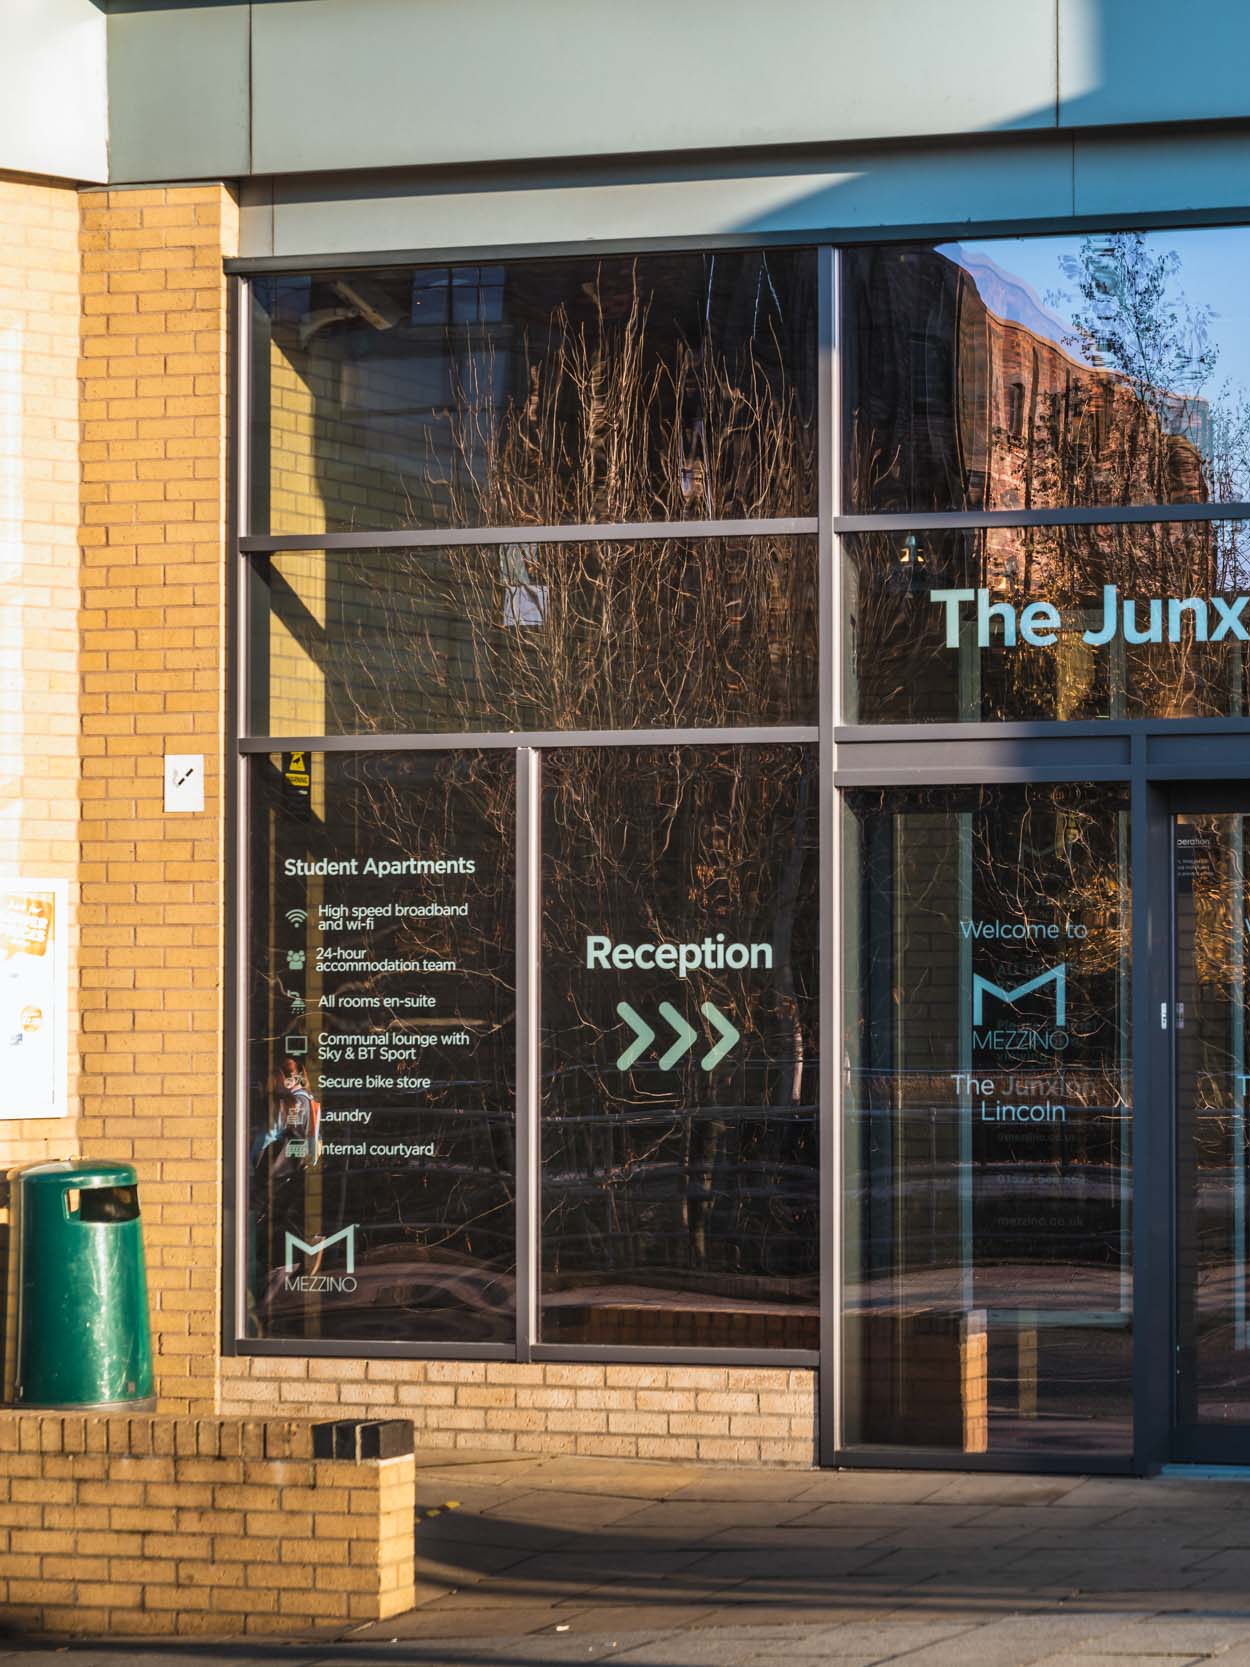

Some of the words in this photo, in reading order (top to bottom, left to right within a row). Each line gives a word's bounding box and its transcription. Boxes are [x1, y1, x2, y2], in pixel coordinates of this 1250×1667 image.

[930, 588, 1060, 648] The
[284, 858, 357, 876] Student
[363, 858, 475, 878] Apartments
[318, 904, 348, 918] High
[352, 904, 391, 918] speed
[395, 902, 468, 916] broadband
[318, 919, 343, 930] and
[346, 917, 374, 930] wi-fi
[960, 920, 1059, 939] Welcome
[1066, 921, 1088, 940] to
[315, 948, 366, 960] 24-hour
[586, 933, 773, 977] Reception
[316, 960, 420, 973] accommodation
[422, 960, 456, 971] team
[319, 996, 335, 1007] All
[338, 998, 380, 1008] rooms
[383, 996, 436, 1008] en-suite
[318, 1033, 389, 1046] Communal
[392, 1033, 437, 1048] lounge
[440, 1032, 469, 1045] with
[972, 1030, 1069, 1051] MEZZINO
[318, 1047, 342, 1062] Sky
[345, 1048, 355, 1059] &
[358, 1048, 376, 1059] BT
[379, 1046, 416, 1062] Sport
[318, 1075, 363, 1088] Secure
[366, 1075, 394, 1088] bike
[396, 1077, 431, 1088] store
[951, 1075, 995, 1095] The
[319, 1109, 372, 1124] Laundry
[981, 1100, 1066, 1122] Lincoln
[369, 1142, 434, 1158] courtyard
[285, 1276, 357, 1292] MEZZINO
